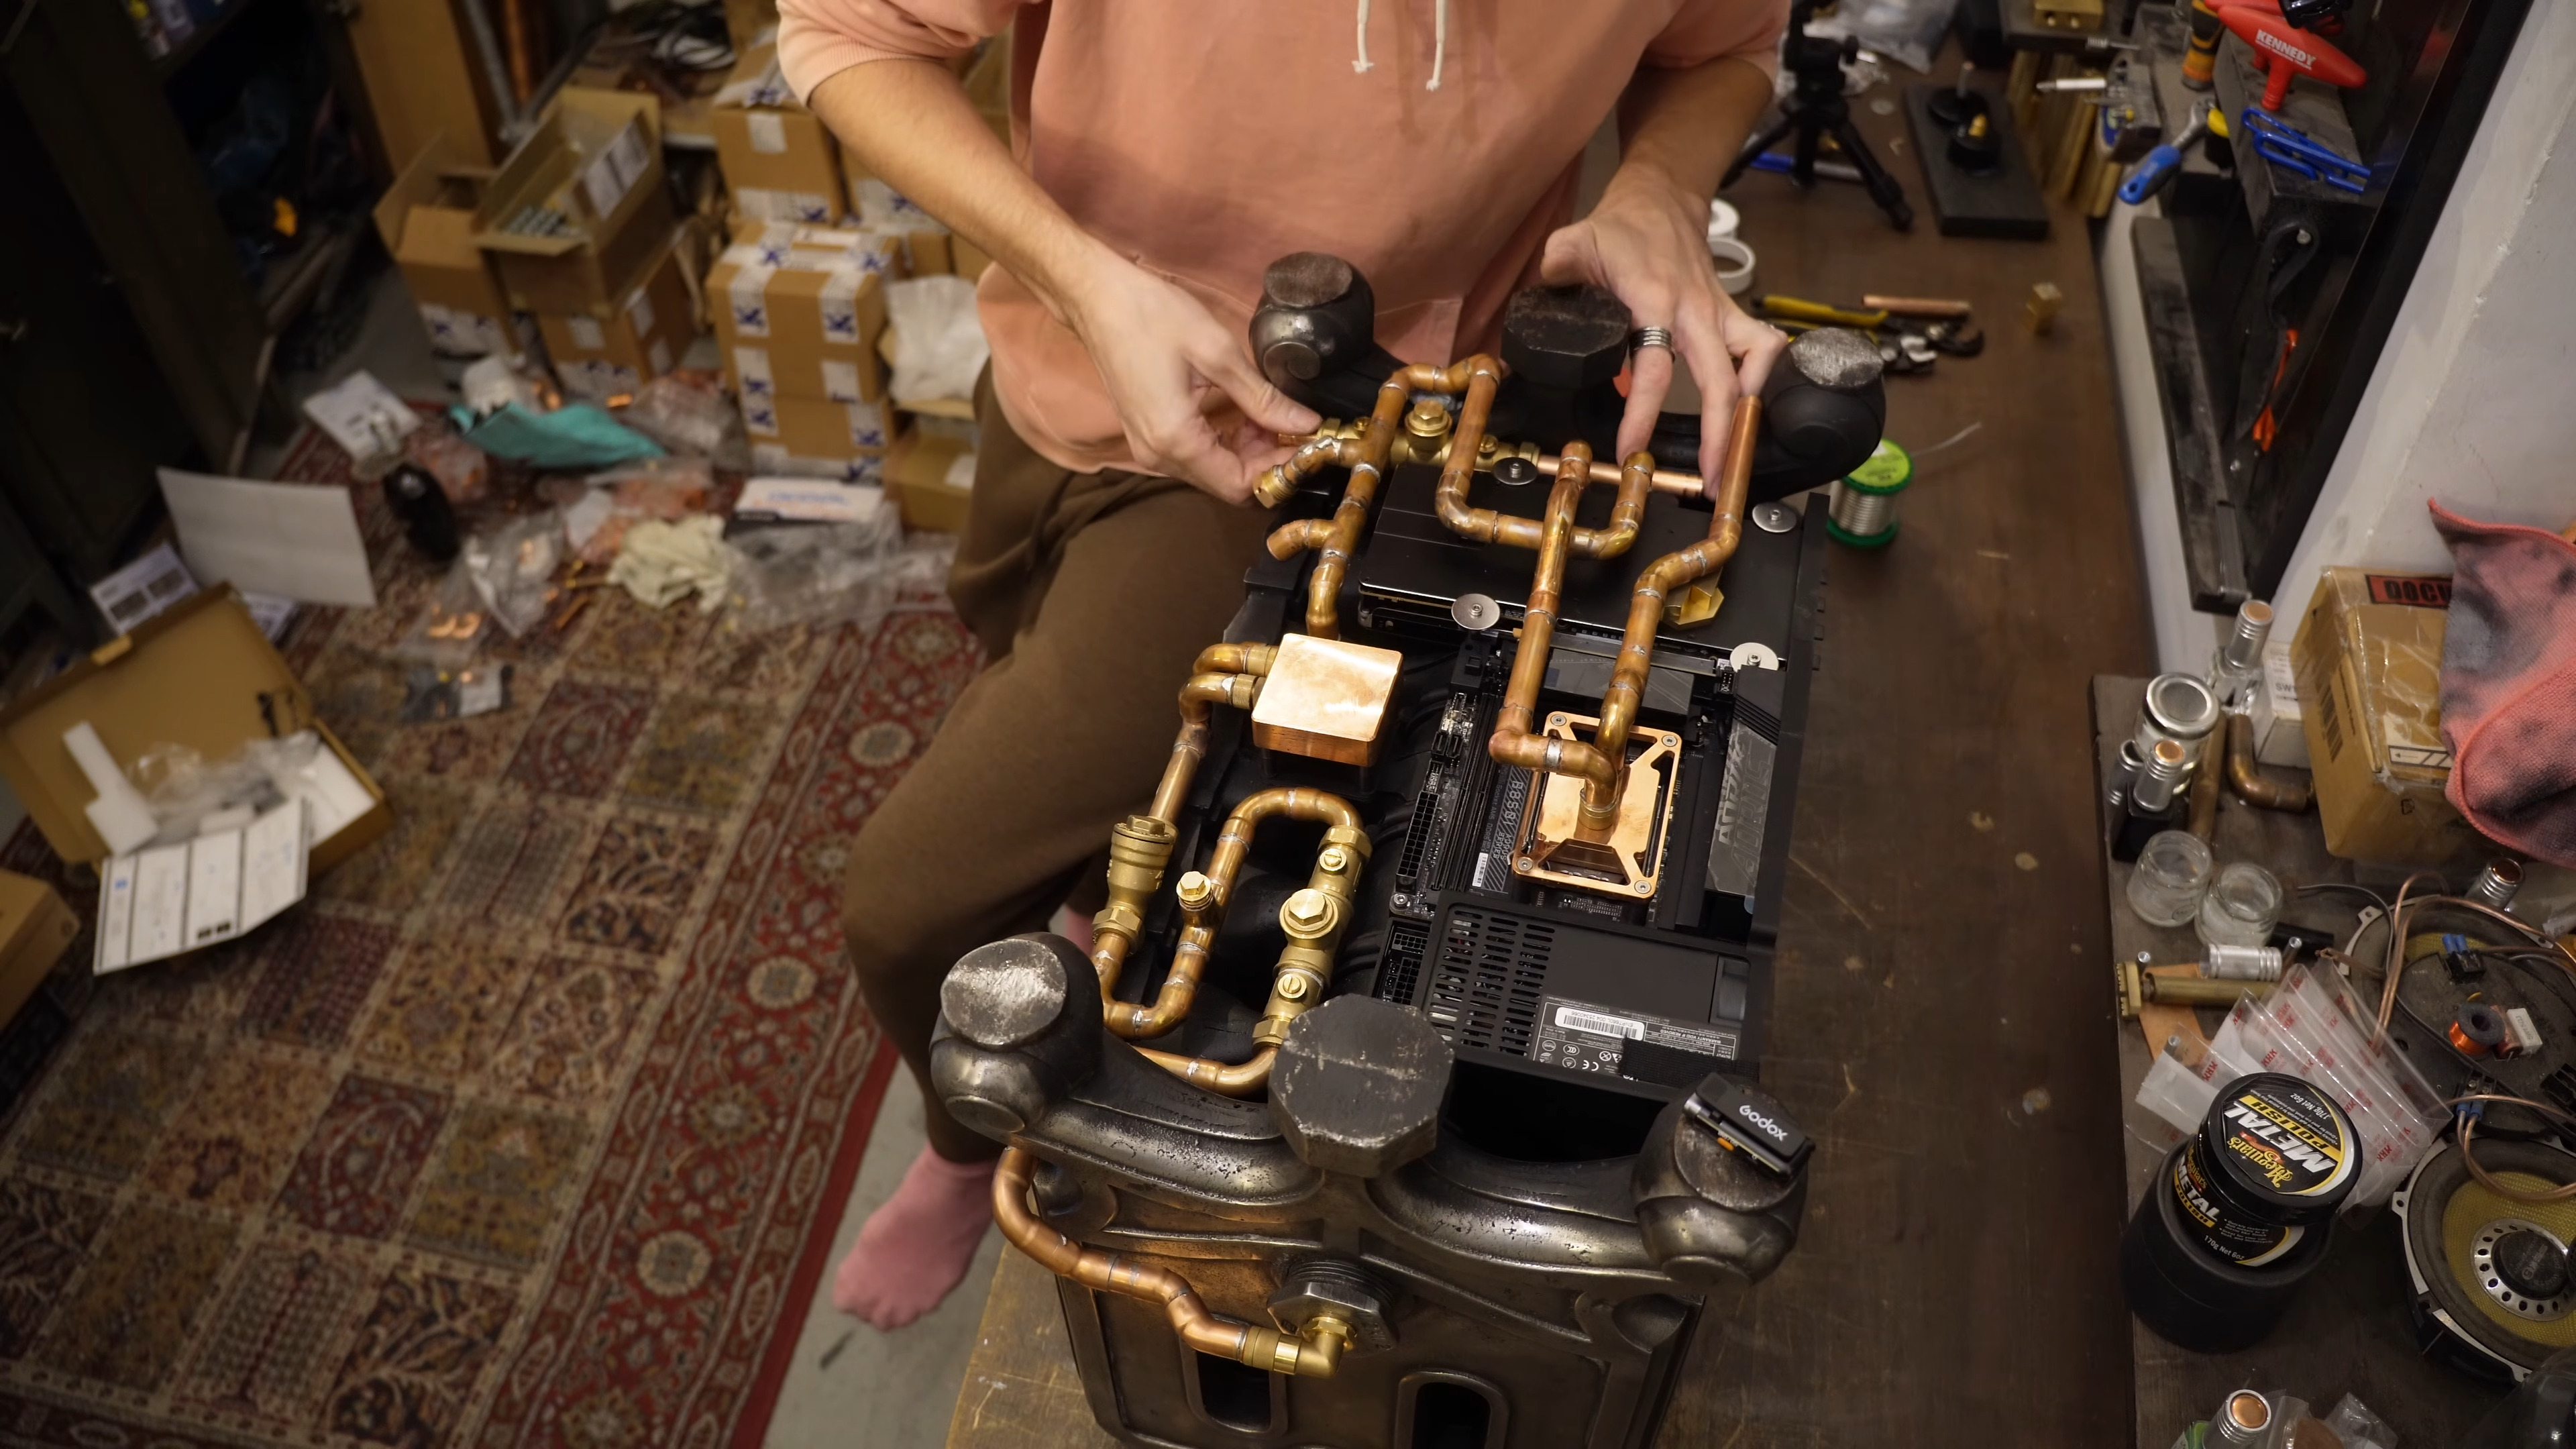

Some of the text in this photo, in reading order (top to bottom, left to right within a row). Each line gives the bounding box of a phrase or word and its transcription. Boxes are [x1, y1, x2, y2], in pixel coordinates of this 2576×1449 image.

[2256, 29, 2316, 66] KENNEDY
[1494, 784, 1503, 807] Socket
[1489, 806, 1497, 820] AM5
[1484, 824, 1493, 841] DDR5
[1493, 831, 1505, 859] SERIES
[1501, 834, 1511, 860] AORUS
[1697, 1036, 1721, 1044] WARRANTY
[2290, 1093, 2304, 1104] 6oz
[2302, 1099, 2314, 1111] Net
[1739, 1105, 1788, 1141] Godox
[2251, 1102, 2329, 1149] POLISH
[2314, 1108, 2330, 1120] 170g
[2224, 1101, 2338, 1173] METAL
[2227, 1136, 2294, 1188] Meguiar's
[2178, 1154, 2220, 1222] METAL
[2176, 1184, 2209, 1223] POLISH
[2204, 1234, 2245, 1260] 170g Net 6oz
